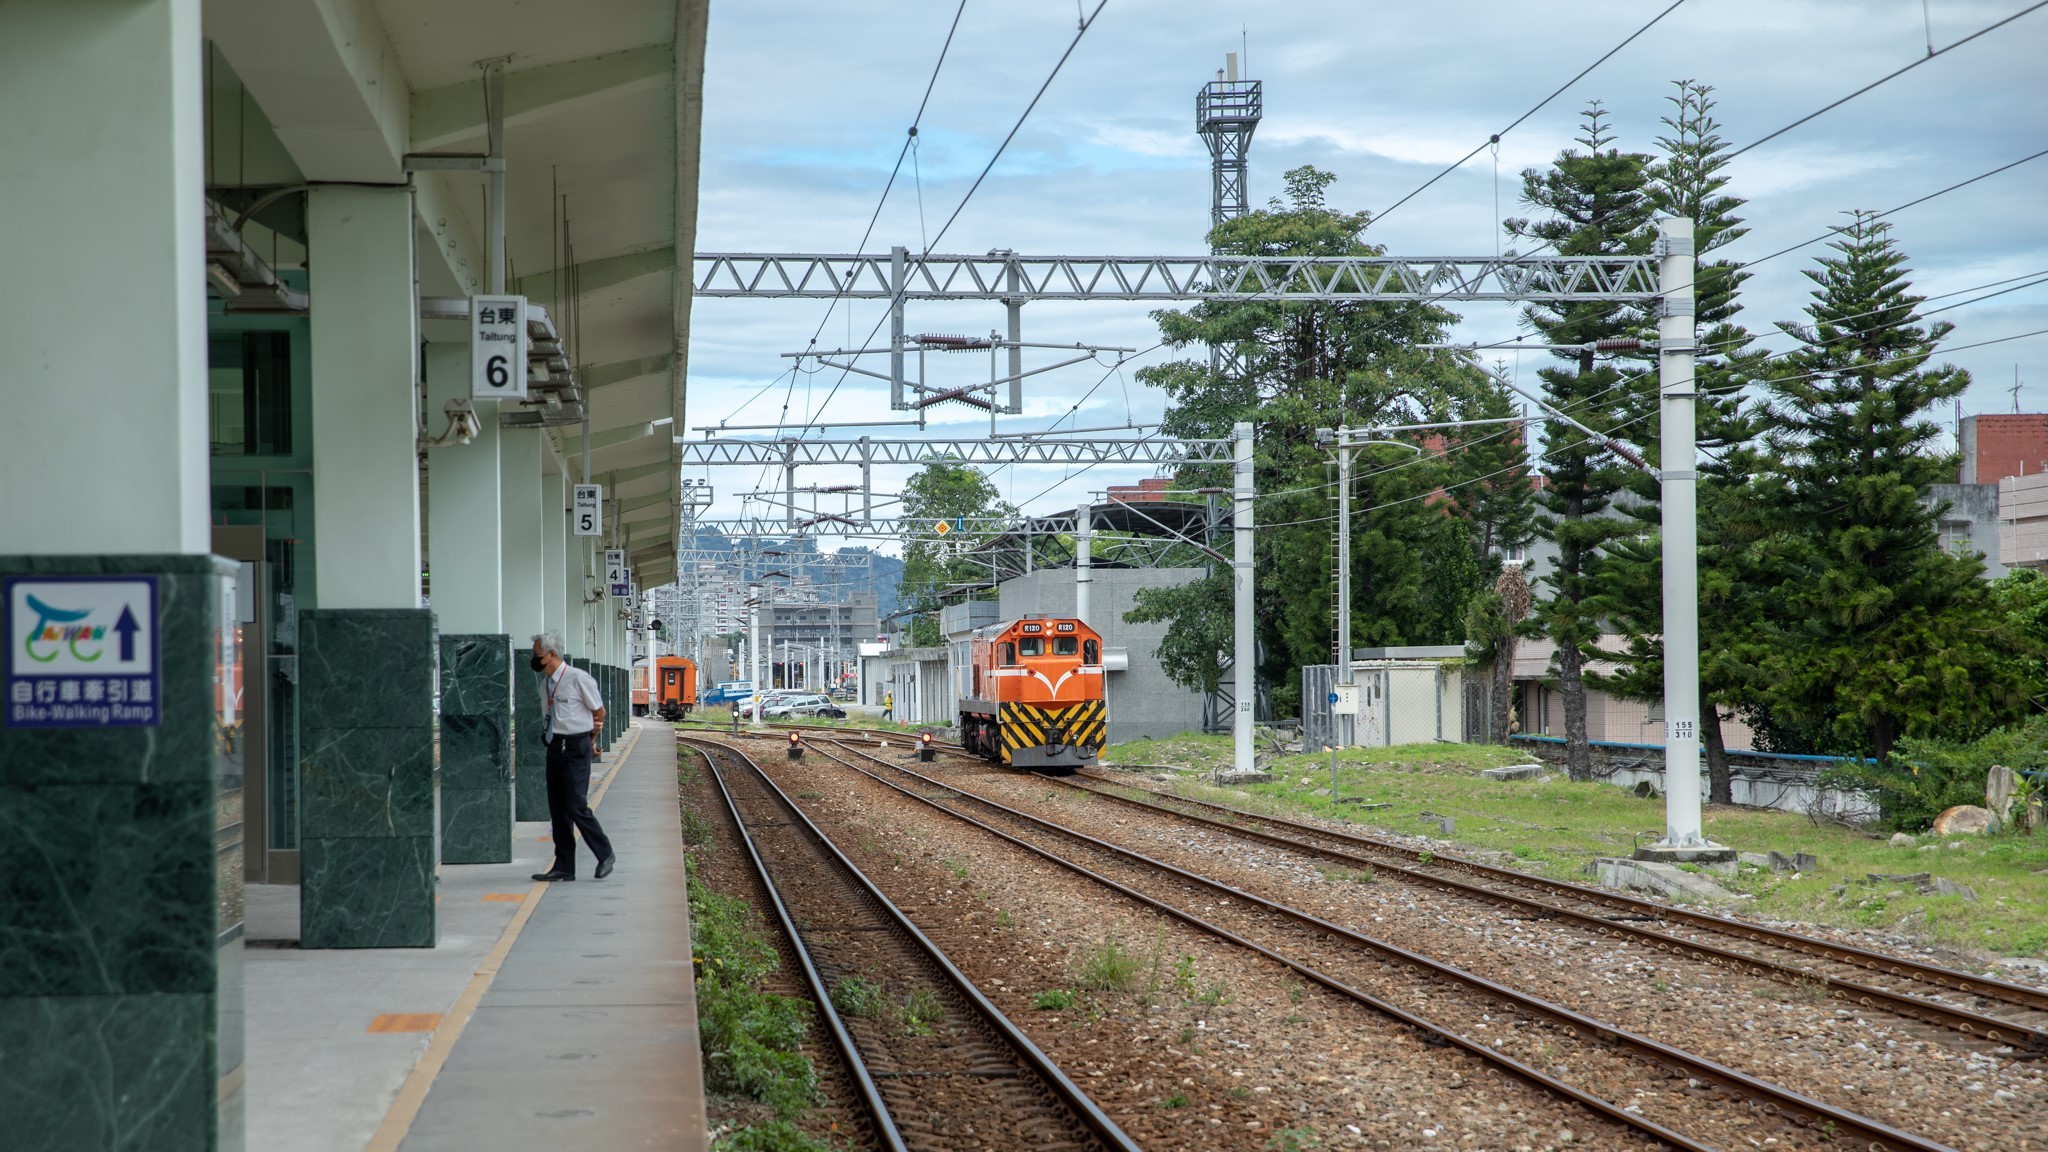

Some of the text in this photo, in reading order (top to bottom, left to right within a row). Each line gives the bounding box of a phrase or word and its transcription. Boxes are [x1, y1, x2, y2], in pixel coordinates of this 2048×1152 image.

[479, 307, 516, 324] 台東
[480, 331, 516, 344] Taitung
[486, 355, 508, 388] 6
[577, 490, 596, 499] 台東
[581, 514, 592, 531] 5
[610, 570, 618, 581] 4
[626, 598, 632, 606] 3
[11, 679, 153, 703] 自行車牽引道
[14, 704, 153, 723] Bike-Walking Ramp
